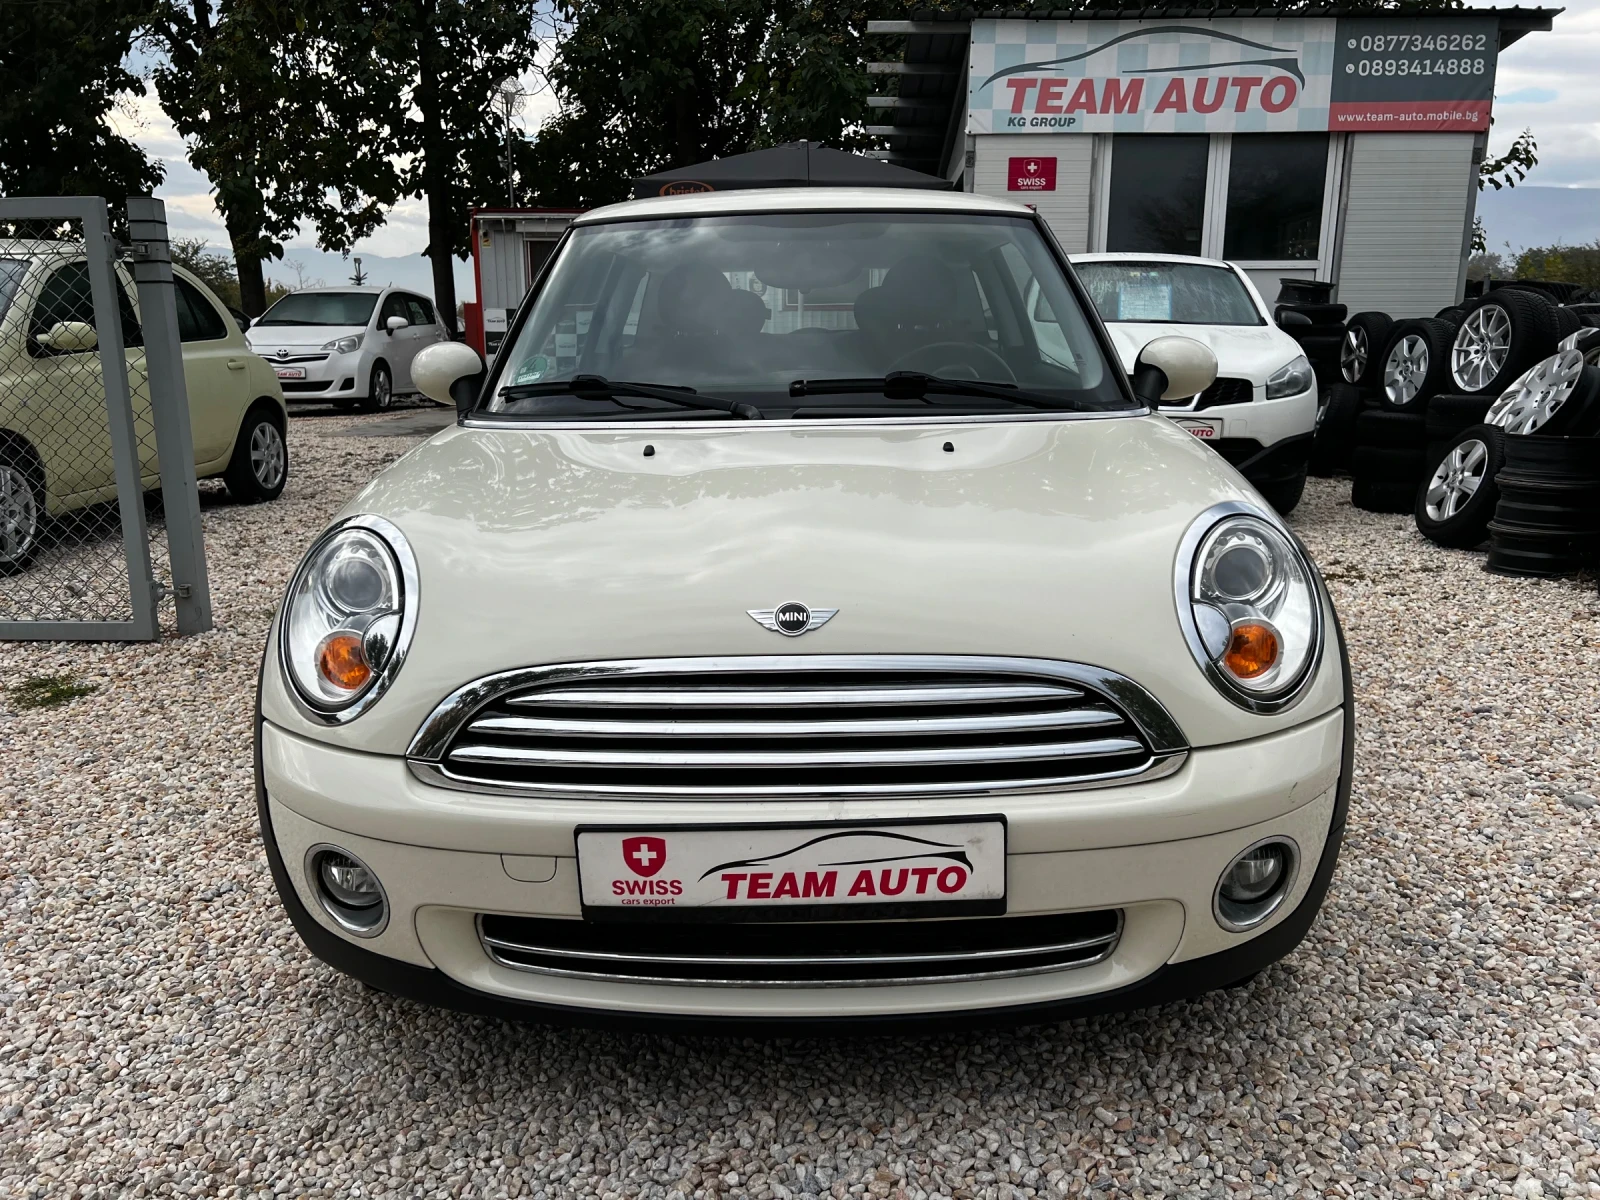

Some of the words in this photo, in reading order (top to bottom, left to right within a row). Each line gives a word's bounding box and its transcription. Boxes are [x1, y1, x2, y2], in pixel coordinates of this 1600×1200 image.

[1360, 34, 1487, 51] 0877346262
[1358, 58, 1485, 76] 0893414888
[1006, 78, 1145, 114] TEAM
[1153, 76, 1297, 114] AUTO
[1007, 117, 1026, 127] KG
[1029, 117, 1076, 127] GROUP
[1337, 111, 1479, 123] www.team-auto.mobile.bg
[1017, 178, 1046, 186] SWISS
[779, 612, 807, 621] MINI
[612, 880, 683, 895] SWISS
[721, 871, 838, 899] TEAM
[848, 866, 967, 897] AUTO
[643, 897, 675, 907] export
